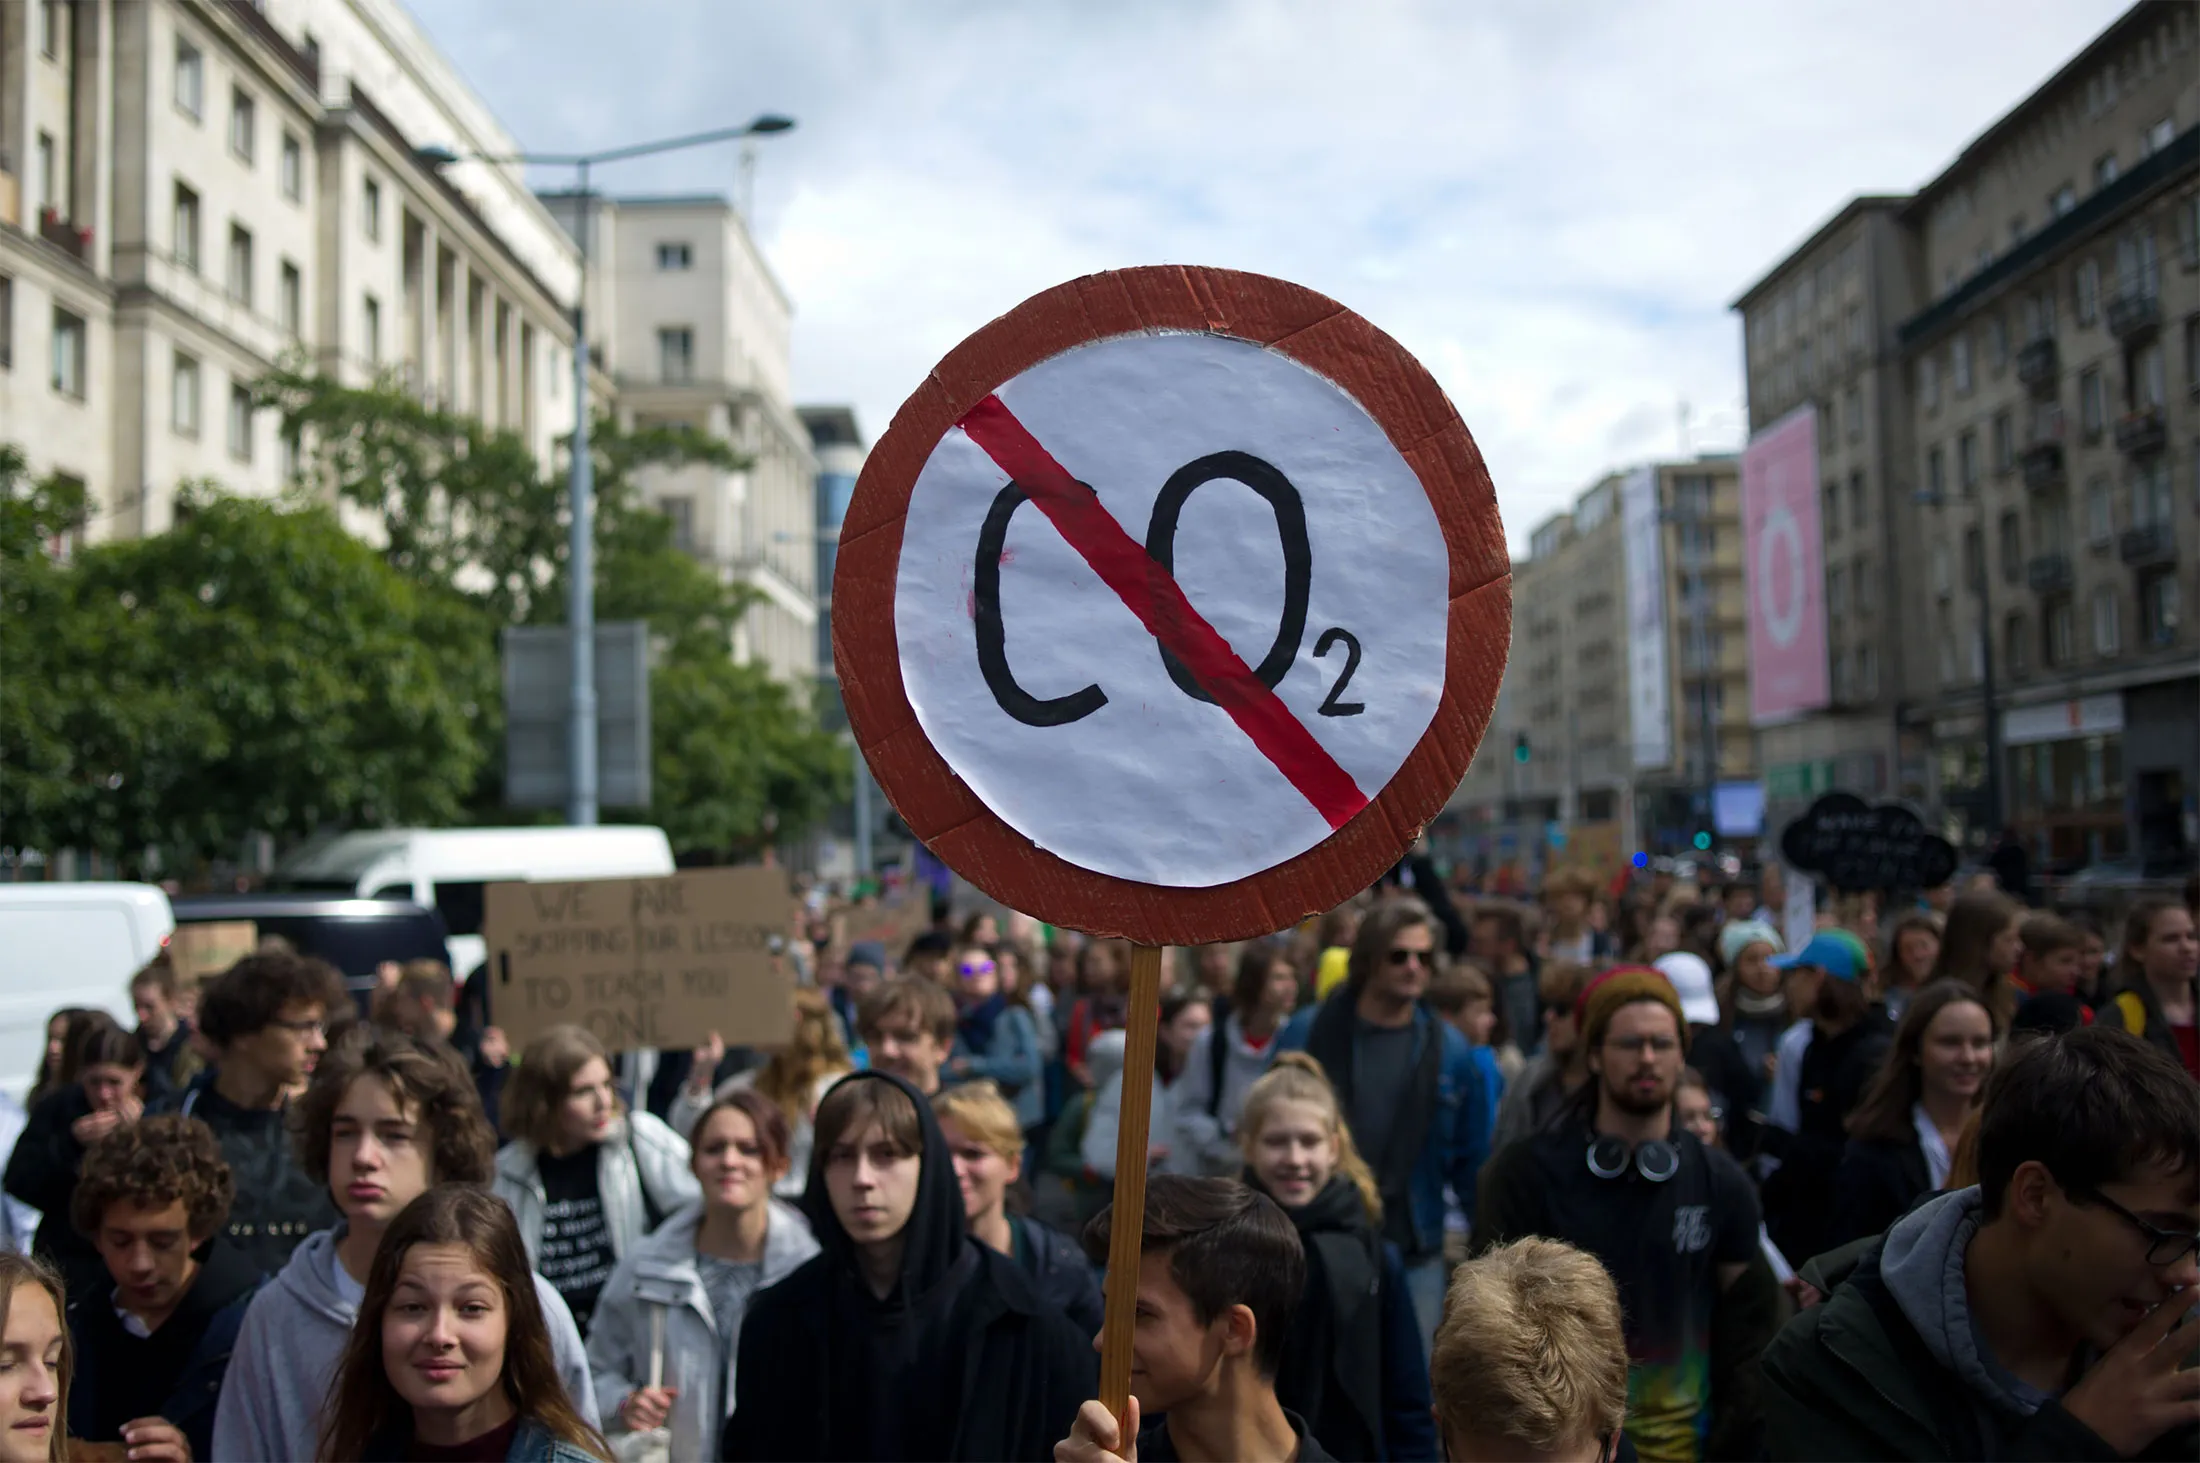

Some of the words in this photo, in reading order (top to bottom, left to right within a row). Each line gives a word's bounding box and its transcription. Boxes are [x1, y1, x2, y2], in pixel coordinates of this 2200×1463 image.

[531, 882, 595, 922] WE
[633, 879, 688, 917] ARE
[523, 974, 572, 1011] TO
[580, 970, 666, 1003] TEACH
[680, 966, 730, 998] YOU
[583, 1003, 672, 1044] ONE
